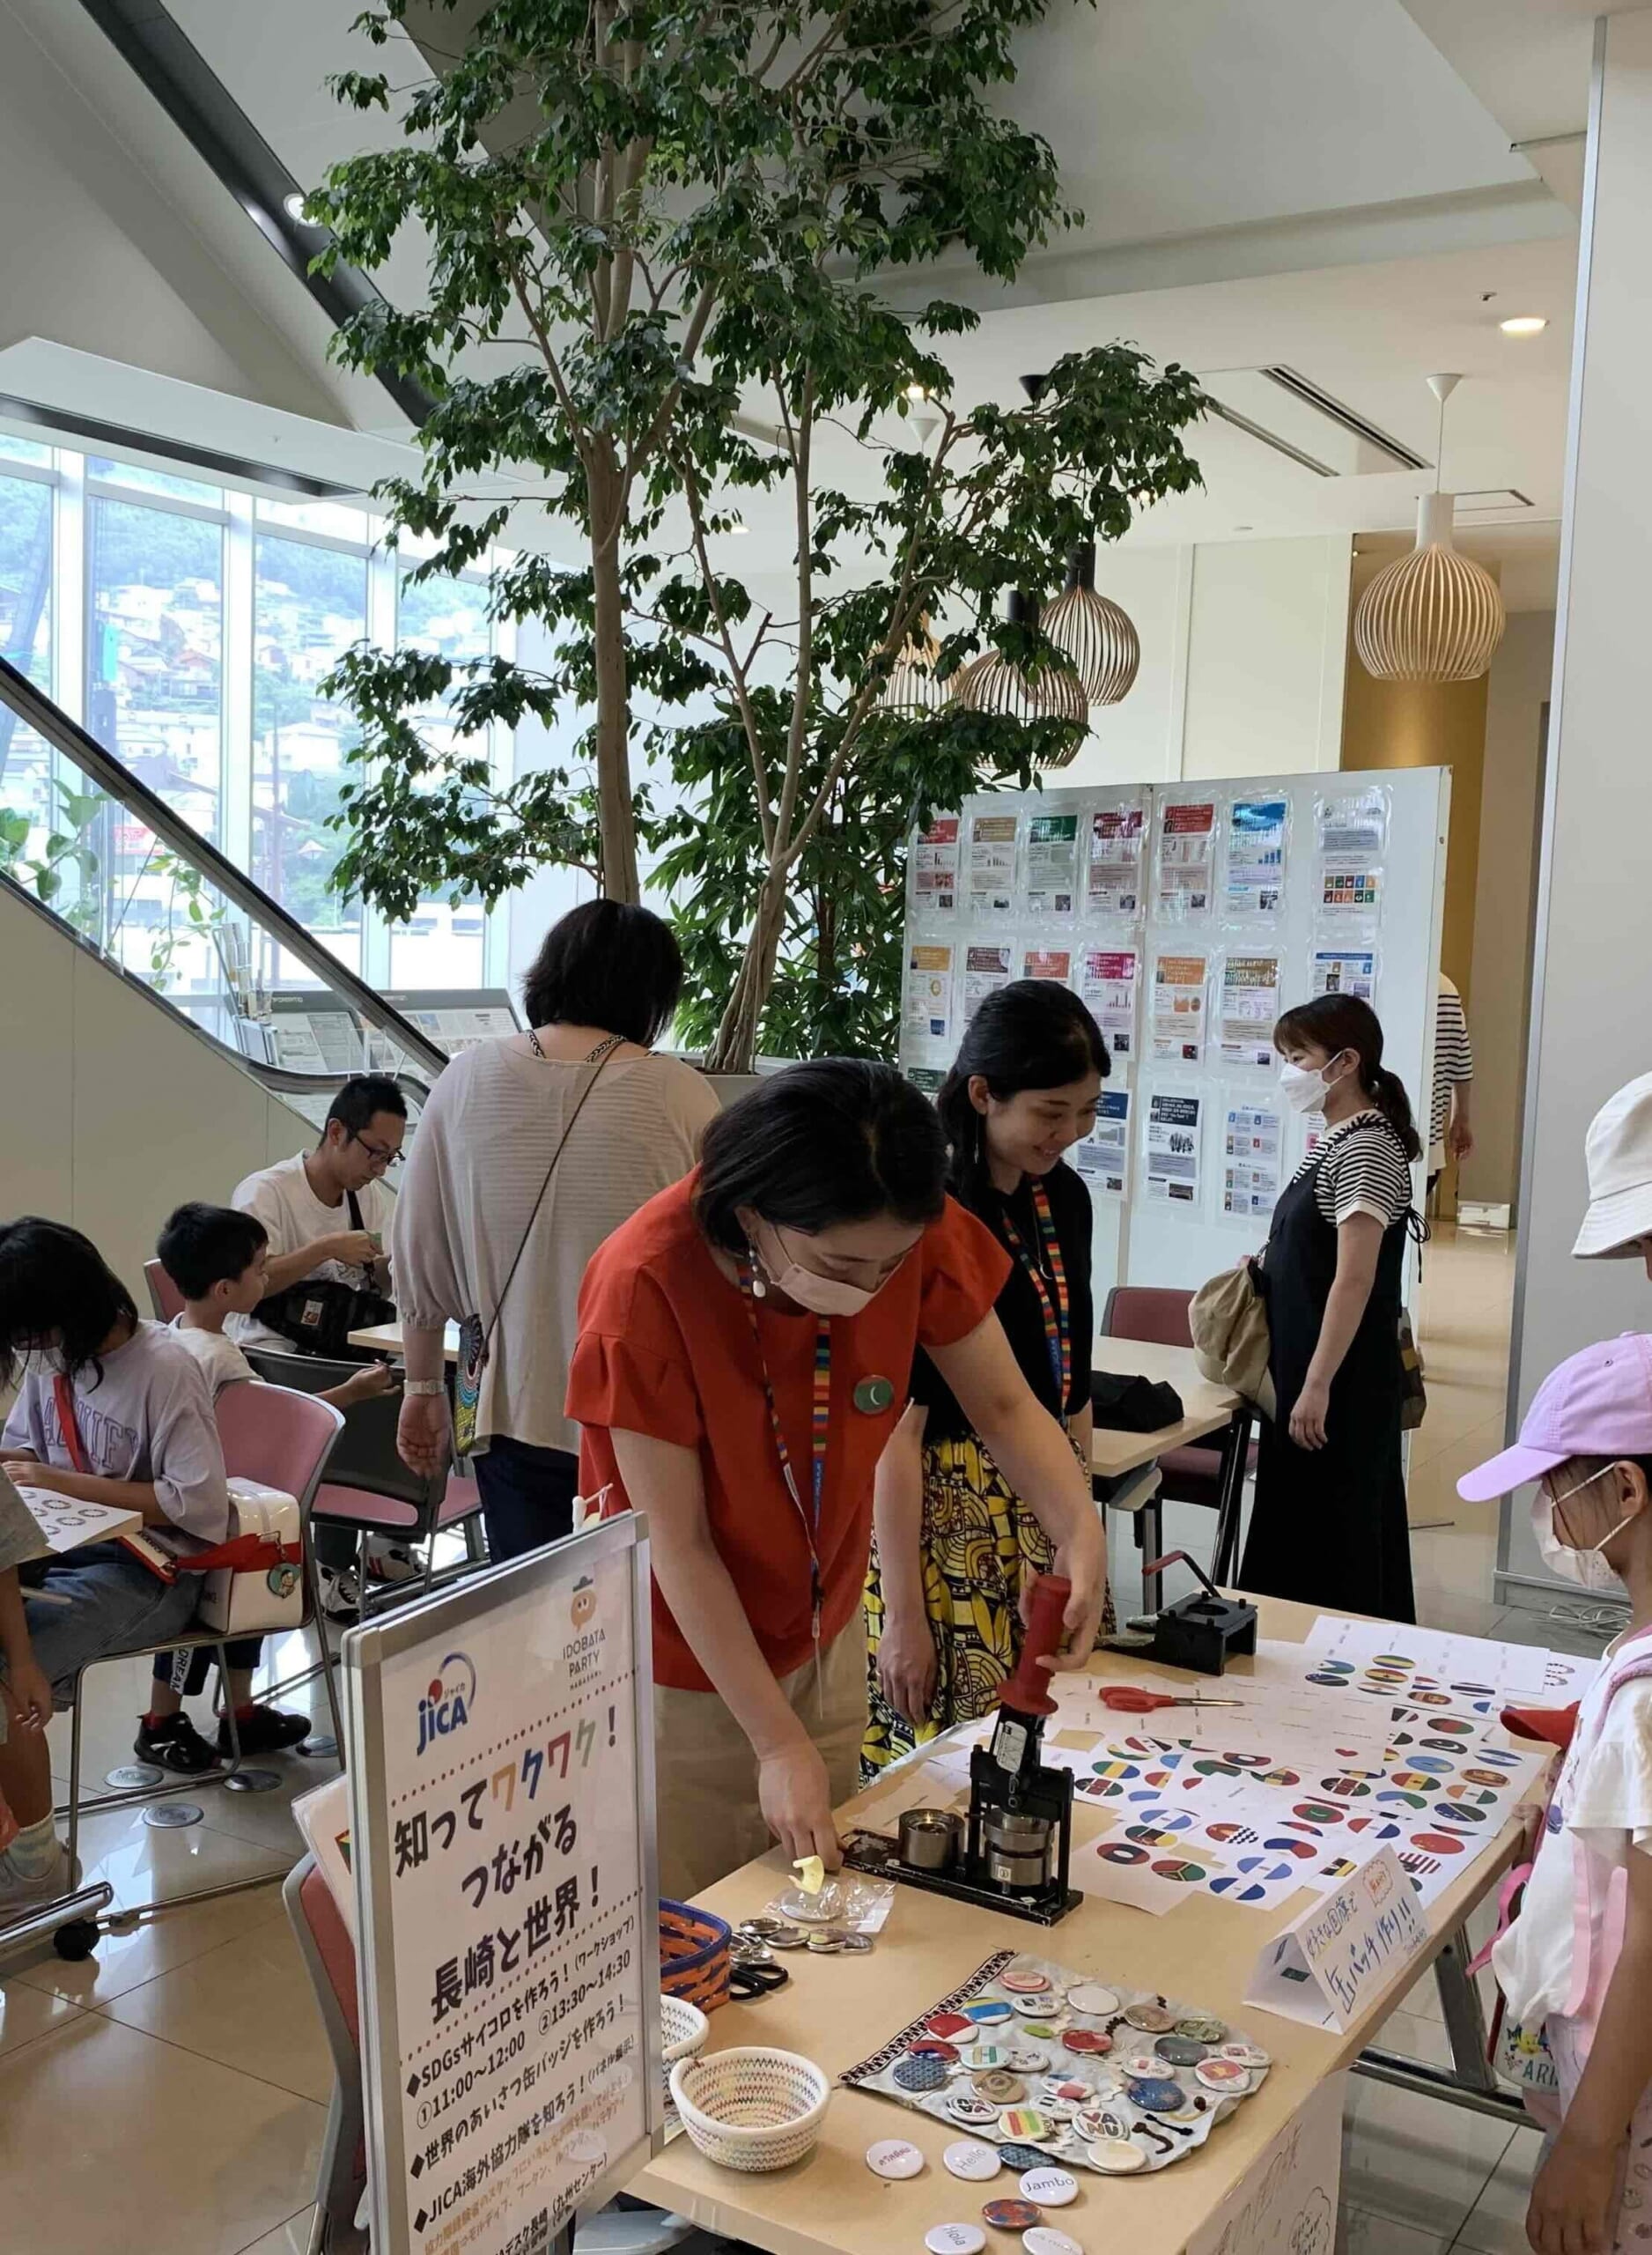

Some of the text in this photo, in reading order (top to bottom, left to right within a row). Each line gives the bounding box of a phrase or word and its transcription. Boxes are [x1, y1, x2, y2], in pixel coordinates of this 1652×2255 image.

[563, 1628, 606, 1660] IDOBATA
[569, 1649, 601, 1677] PARTY
[461, 1803, 578, 1908] つながる
[431, 1865, 599, 2025] 長崎と世界！
[955, 2148, 987, 2172] Hello
[1025, 2176, 1074, 2192] Jambo
[943, 2225, 967, 2247] Hola
